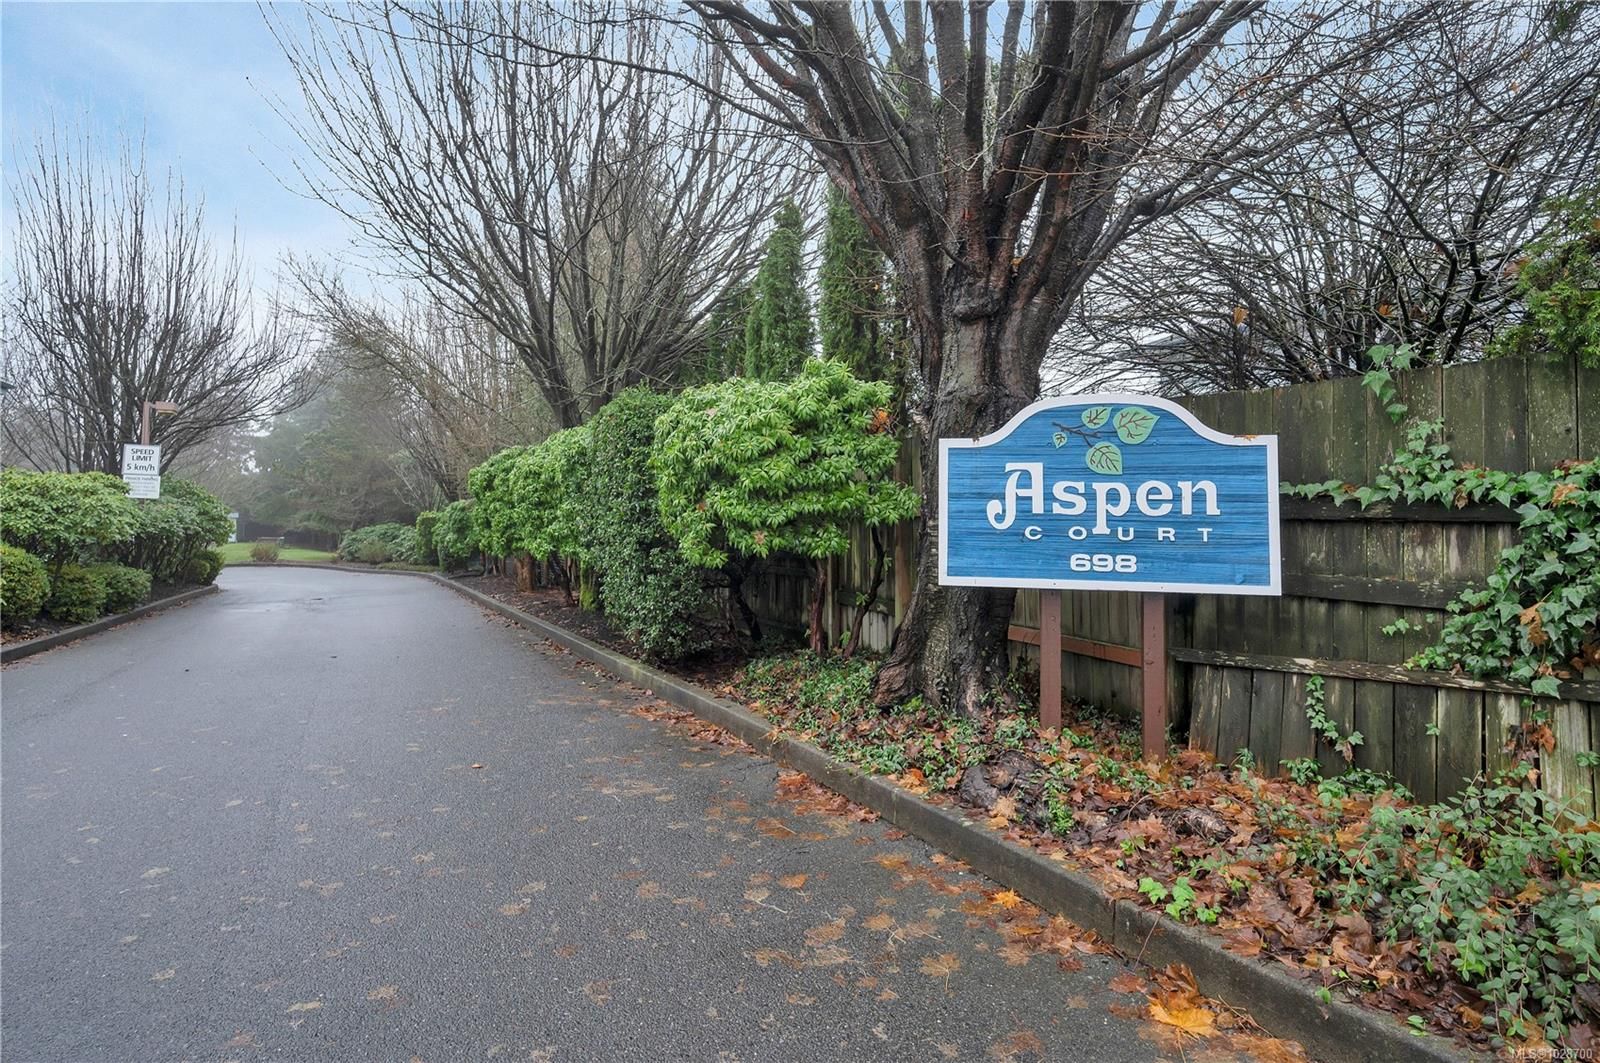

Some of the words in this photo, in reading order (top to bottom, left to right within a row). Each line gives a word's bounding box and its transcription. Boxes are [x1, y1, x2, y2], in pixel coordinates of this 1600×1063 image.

[134, 463, 155, 472] km/h
[986, 461, 1221, 535] Aspen
[1024, 526, 1213, 542] COURT
[1069, 554, 1138, 574] 698
